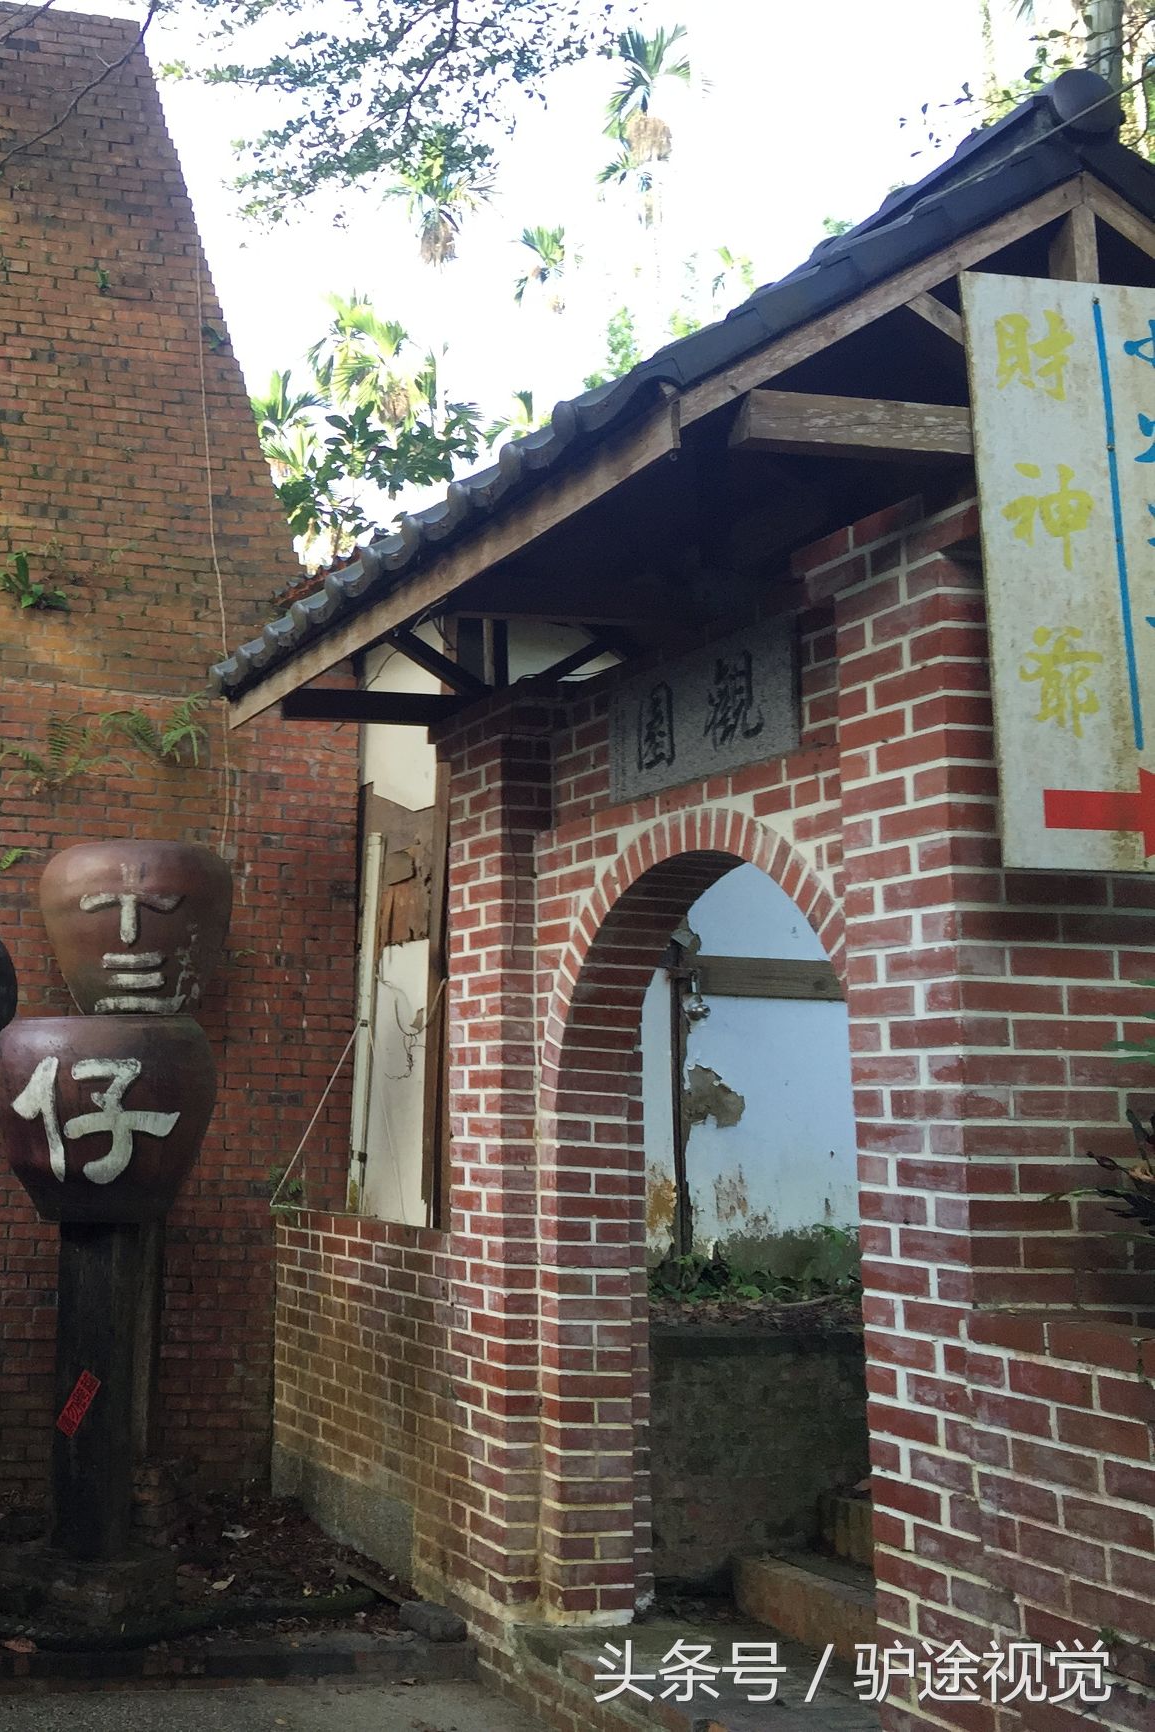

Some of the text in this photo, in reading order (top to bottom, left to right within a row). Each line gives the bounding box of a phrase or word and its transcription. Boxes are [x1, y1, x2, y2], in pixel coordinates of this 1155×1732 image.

[994, 309, 1104, 740] 財神爺
[11, 1055, 182, 1185] 仔
